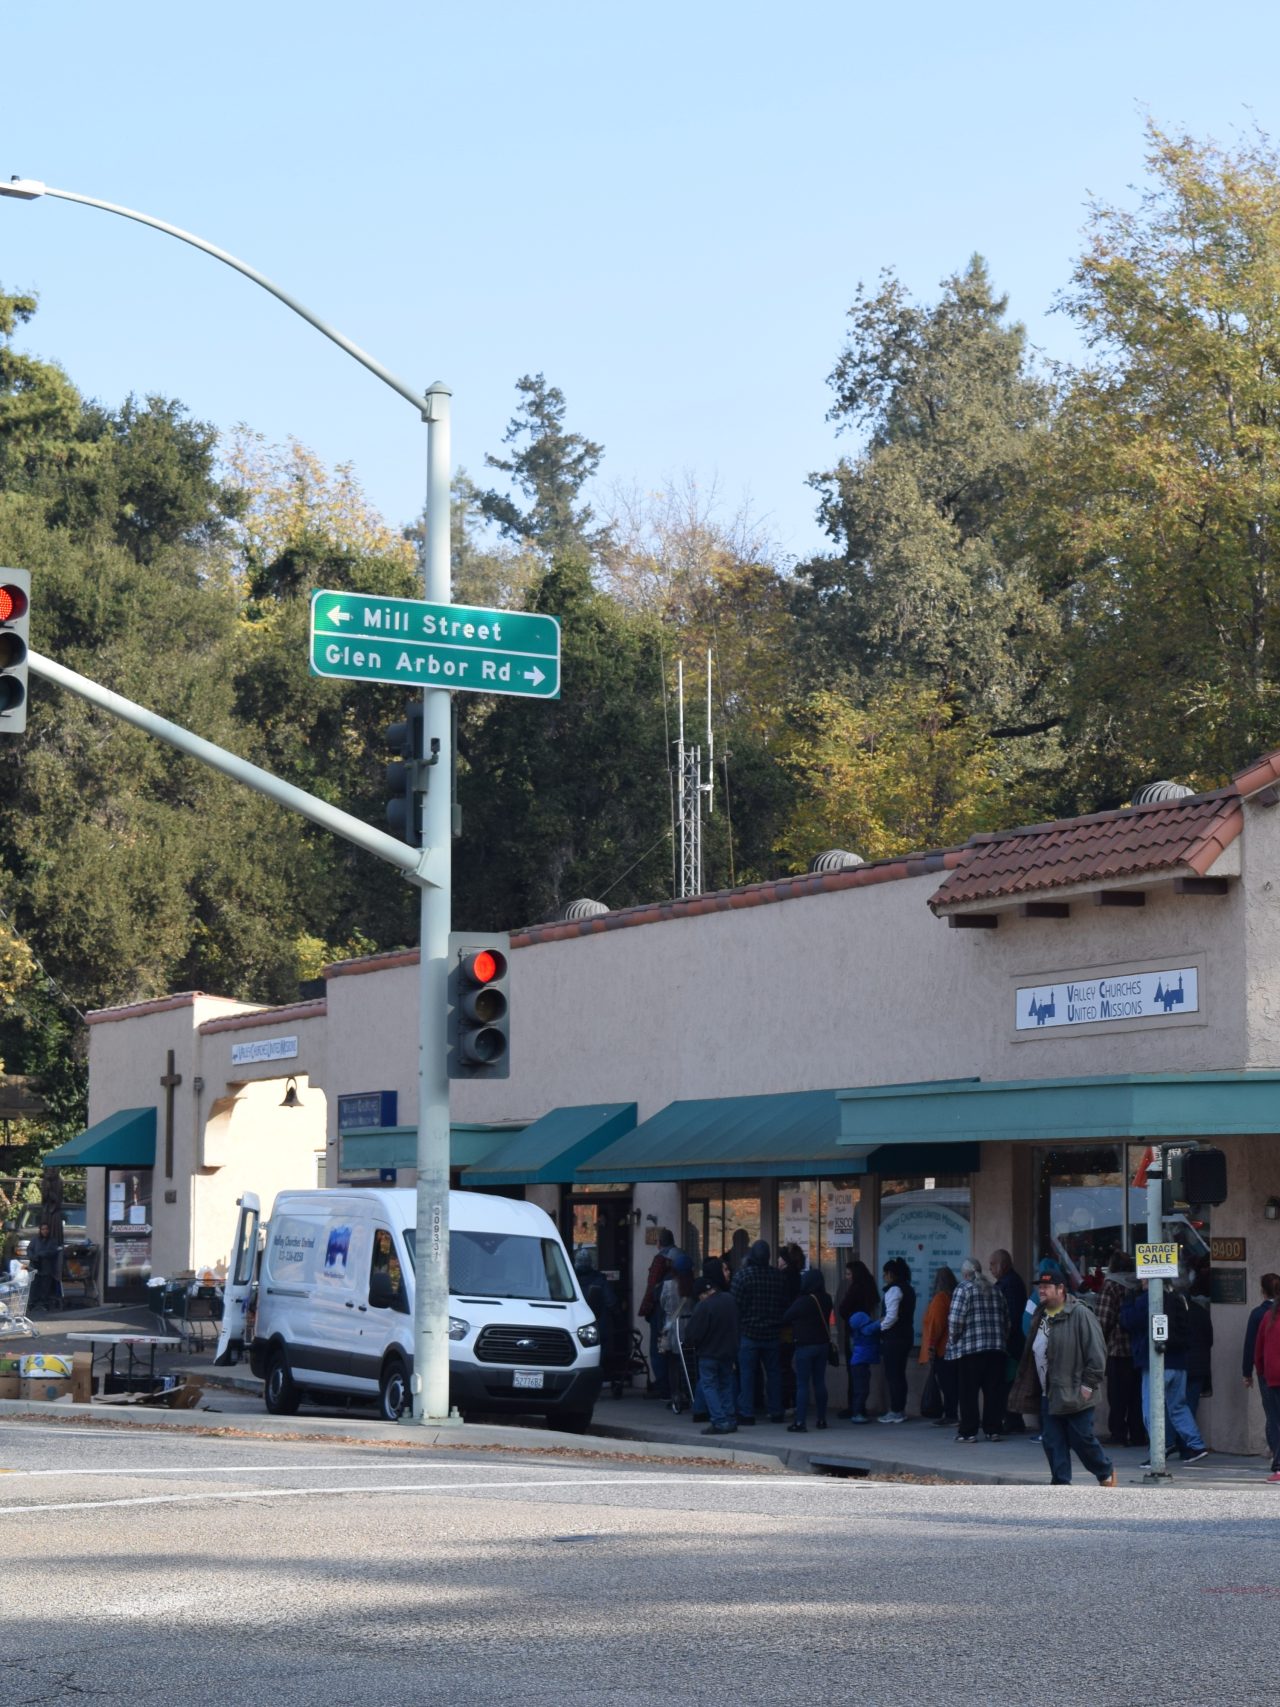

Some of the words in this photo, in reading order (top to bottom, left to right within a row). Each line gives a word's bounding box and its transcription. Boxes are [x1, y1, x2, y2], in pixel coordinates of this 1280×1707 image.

[363, 607, 409, 632] Mill
[422, 614, 502, 641] Street
[325, 644, 382, 669] Glen
[396, 651, 469, 677] Arbor
[482, 660, 511, 681] Rd
[1067, 984, 1096, 1003] VALLEY
[1099, 980, 1142, 999] CHURCHES
[1068, 1005, 1097, 1022] UNITED
[1100, 1000, 1143, 1019] MISSIONS
[834, 1217, 853, 1228] KSCO
[1138, 1244, 1176, 1254] GARAGE
[1142, 1253, 1172, 1264] SALE
[1212, 1241, 1241, 1257] 9400
